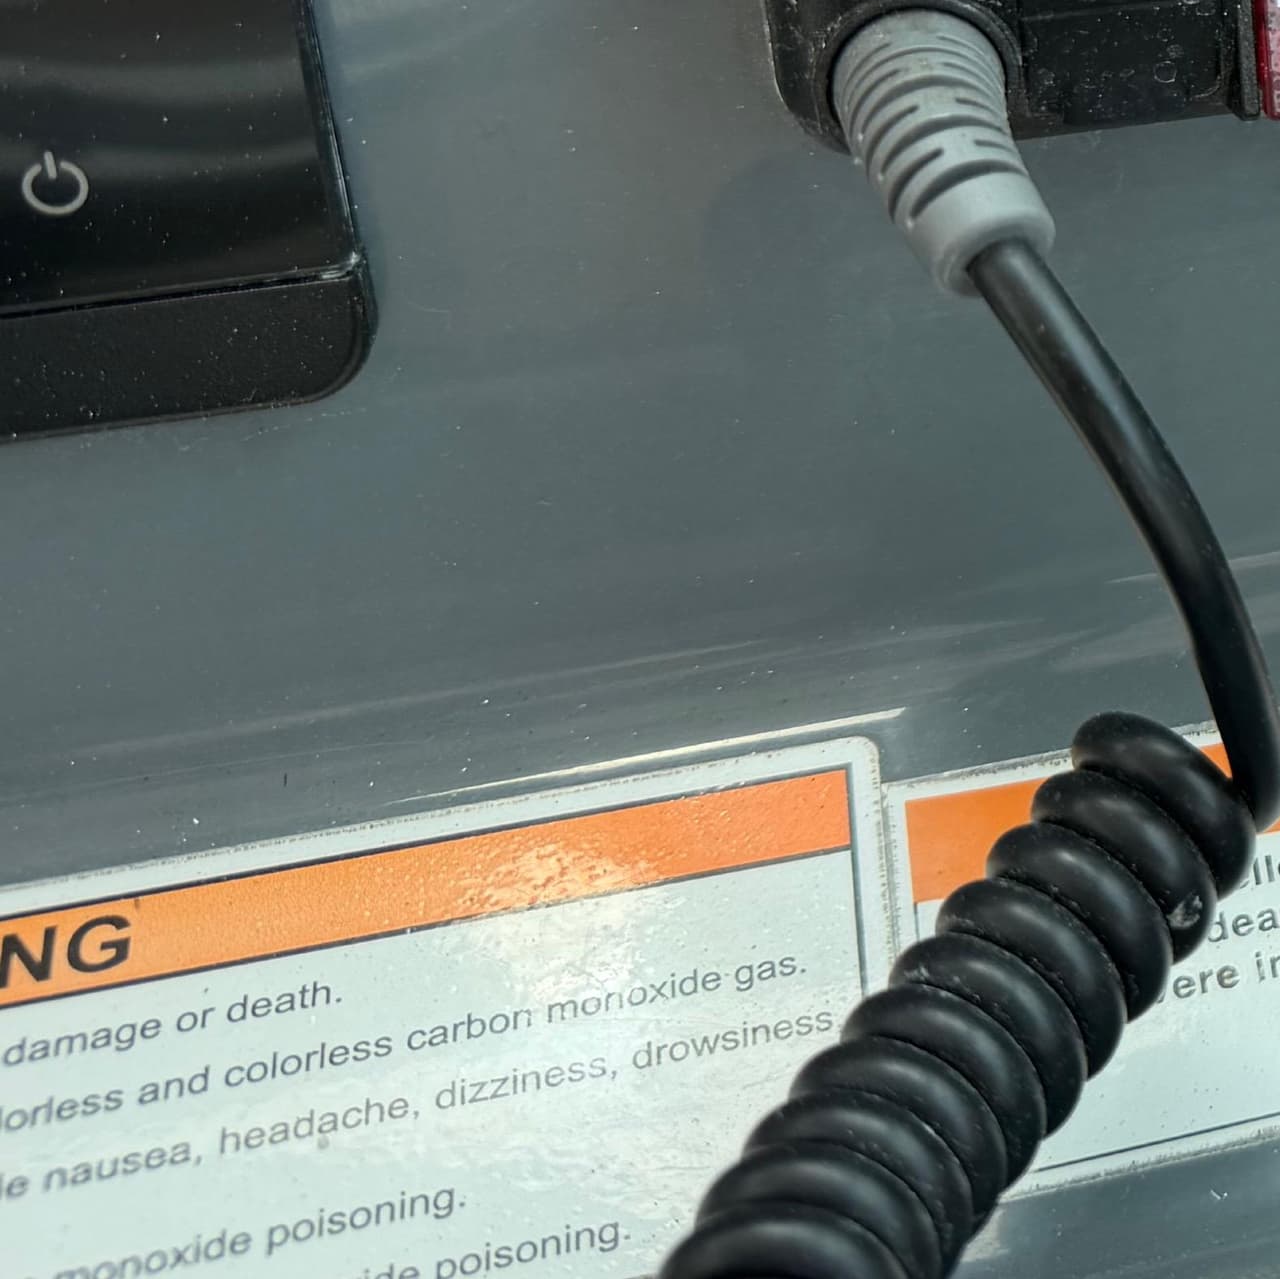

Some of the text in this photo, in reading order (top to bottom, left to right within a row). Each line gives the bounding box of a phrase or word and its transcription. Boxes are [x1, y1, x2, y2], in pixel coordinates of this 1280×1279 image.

[1156, 963, 1241, 1004] ere
[0, 954, 808, 1133] orless and colorless carbon monoxide gas.
[2, 980, 343, 1068] damage or death.
[42, 1140, 203, 1194] nausea,
[218, 1094, 420, 1156] headache,
[435, 1056, 619, 1111] dizziness,
[632, 1010, 834, 1071] drowsiness
[266, 1186, 467, 1258] poisoning.
[436, 1220, 632, 1279] poisoning.
